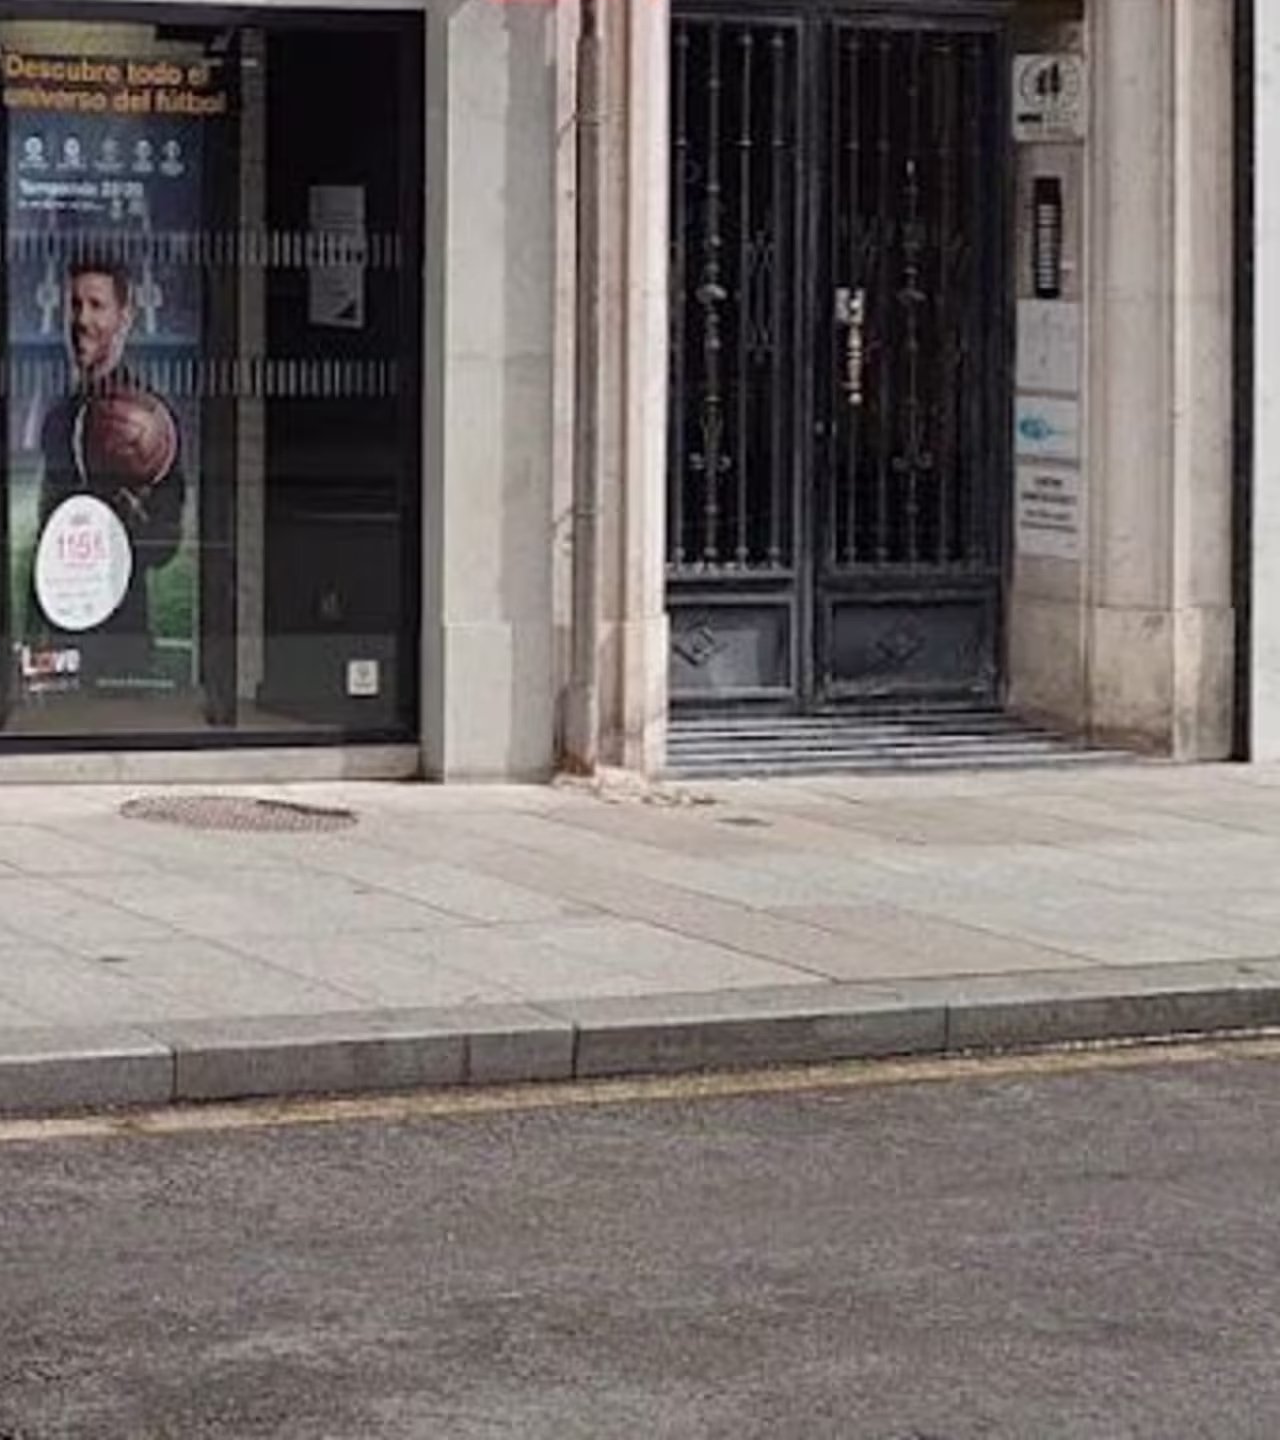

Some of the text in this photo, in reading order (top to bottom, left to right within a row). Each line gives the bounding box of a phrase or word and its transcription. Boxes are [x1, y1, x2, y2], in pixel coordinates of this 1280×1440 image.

[6, 54, 122, 83] Descubre
[127, 60, 183, 85] todo
[112, 89, 151, 112] del
